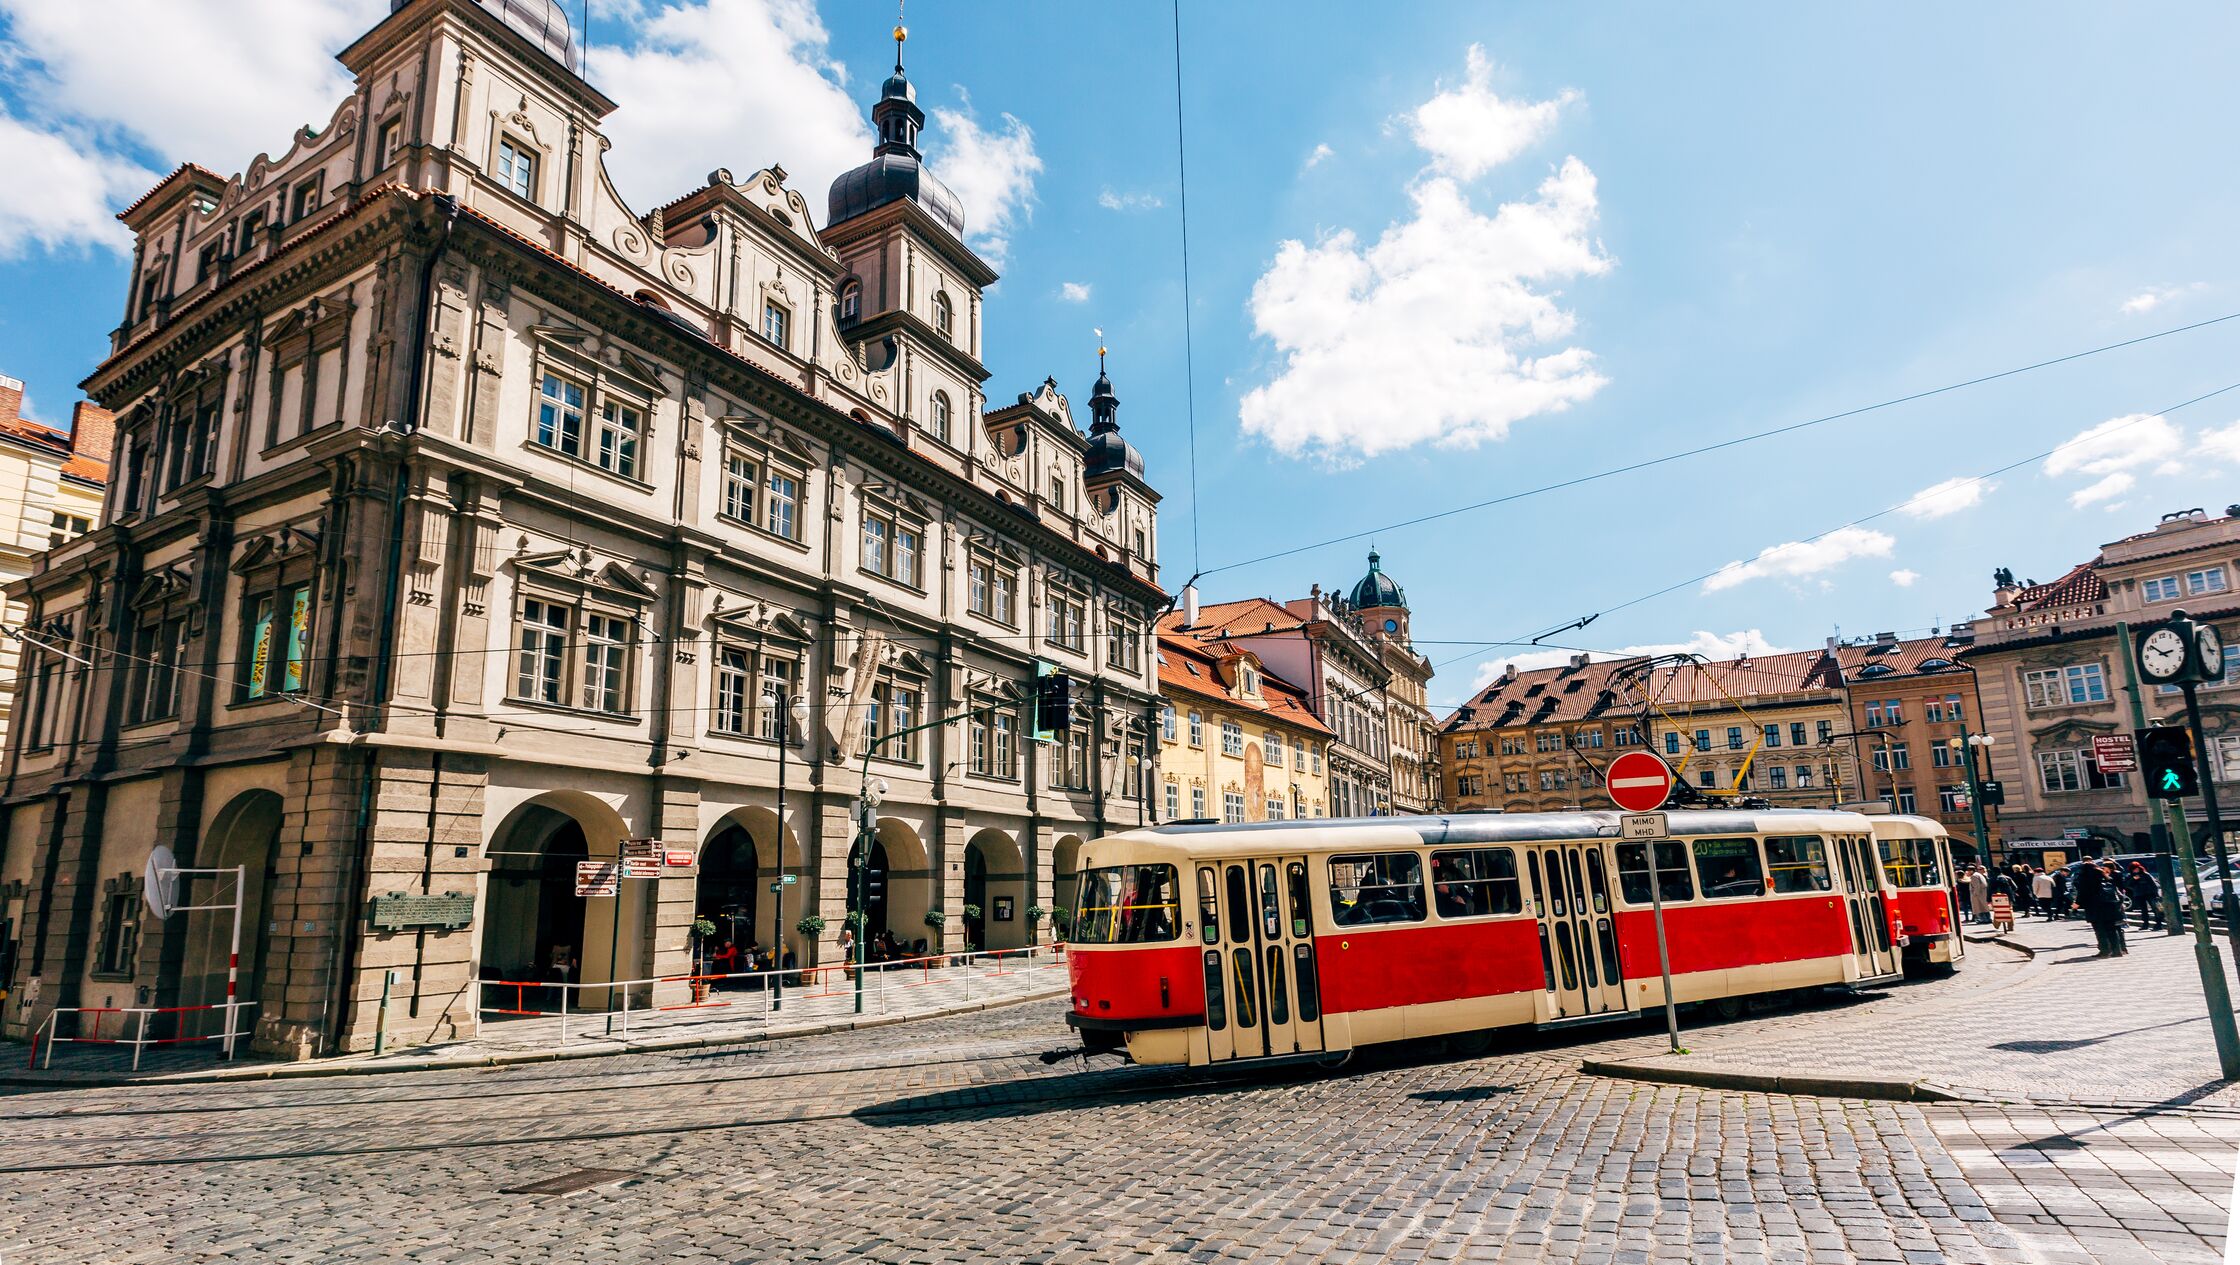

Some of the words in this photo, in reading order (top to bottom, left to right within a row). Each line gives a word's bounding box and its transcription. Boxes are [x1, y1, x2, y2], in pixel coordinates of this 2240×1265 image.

[1632, 817, 1655, 826] MIMO
[1634, 828, 1655, 837] MHD
[1693, 841, 1708, 856] 20
